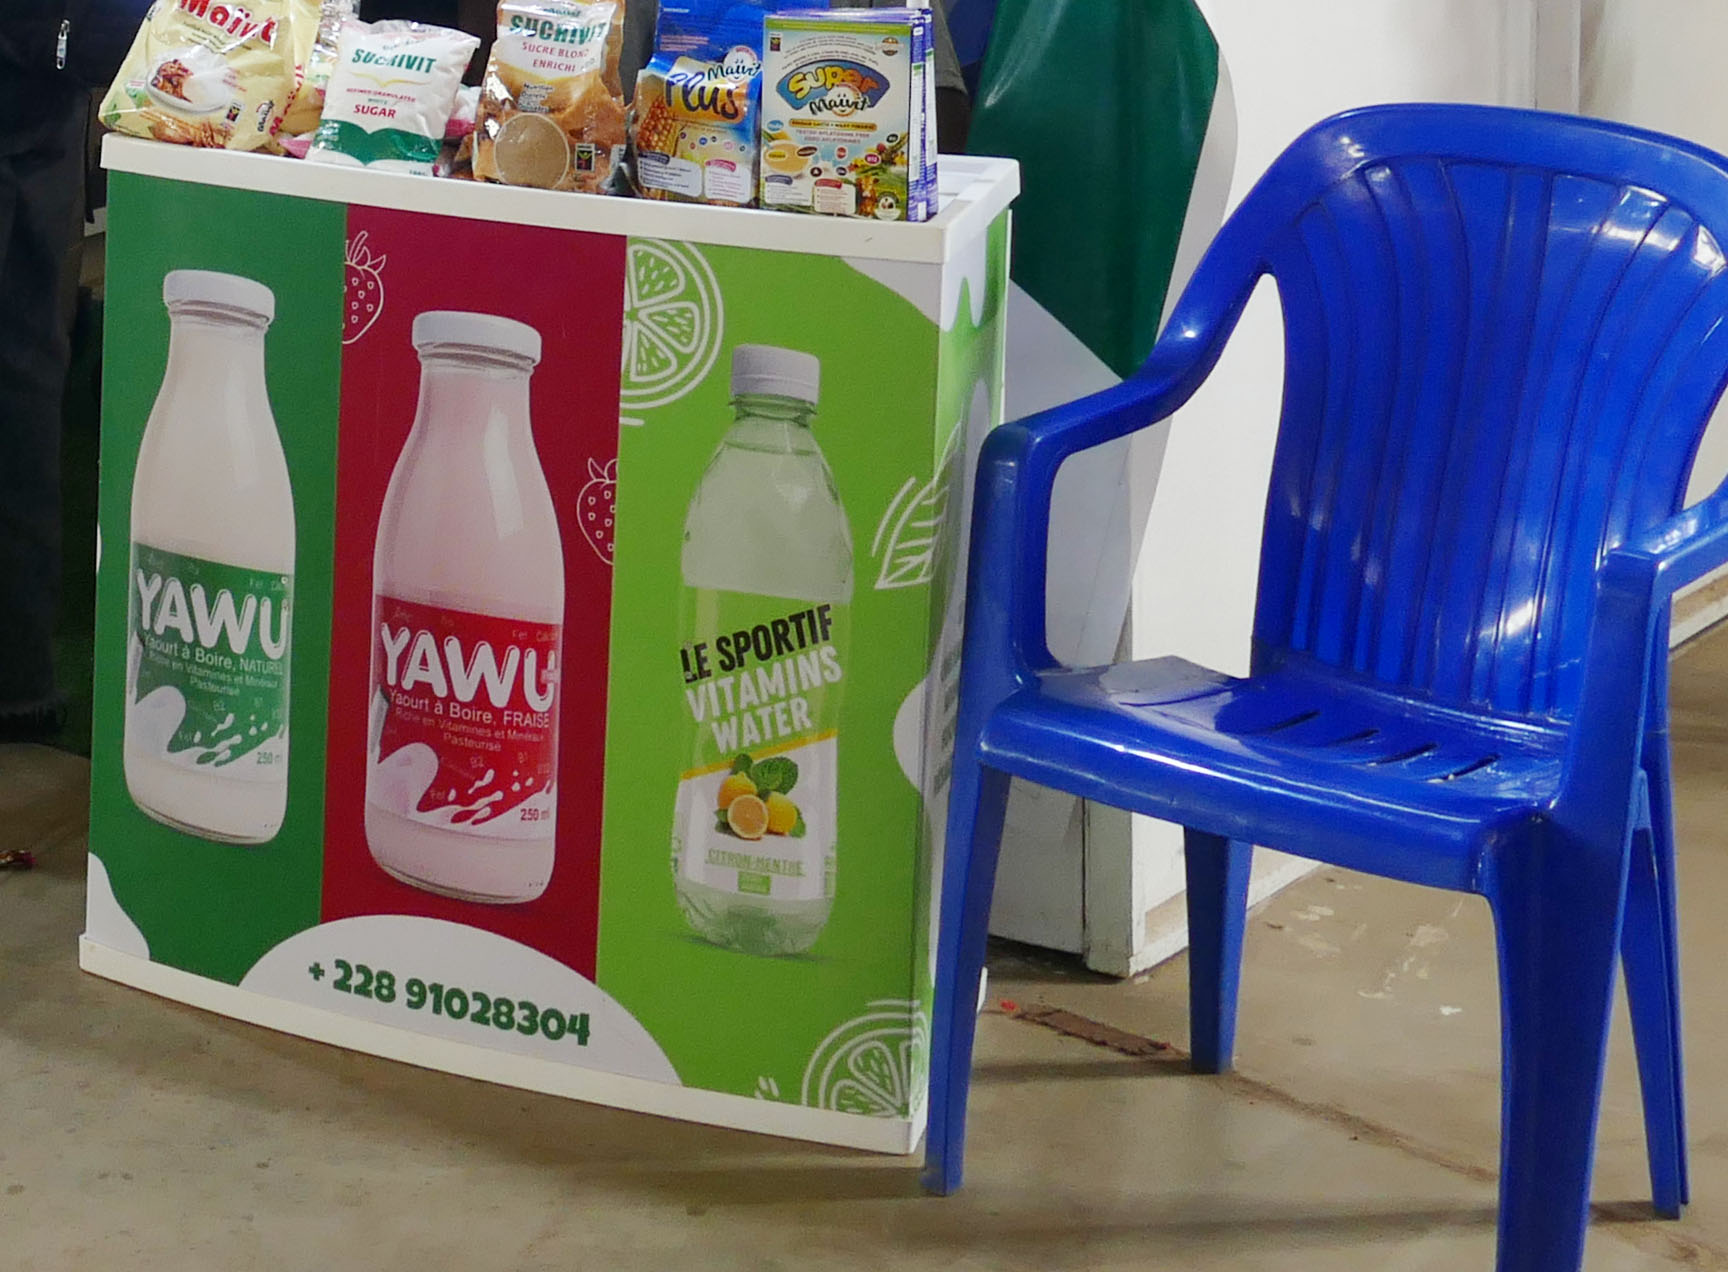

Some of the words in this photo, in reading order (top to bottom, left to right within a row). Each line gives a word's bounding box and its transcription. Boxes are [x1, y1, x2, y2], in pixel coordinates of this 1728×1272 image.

[522, 41, 554, 55] SUCRE
[532, 57, 576, 73] ENRICHI
[353, 103, 397, 119] SUGAR
[137, 567, 289, 660] YAWU
[144, 631, 179, 656] Yaourt
[182, 643, 190, 659] à
[195, 647, 236, 673] Boire,
[680, 641, 712, 684] LE
[715, 603, 833, 674] SPORTIF
[380, 622, 557, 712] YAWU
[685, 644, 843, 723] VITAMINS
[389, 688, 429, 713] Yaourt
[434, 701, 444, 715] à
[503, 710, 550, 729] FRAISE
[438, 717, 492, 738] Vitamines
[711, 696, 813, 755] WATER
[520, 808, 540, 822] 250
[308, 961, 325, 981] +
[333, 958, 396, 1004] 228
[405, 977, 591, 1047] 91028304
